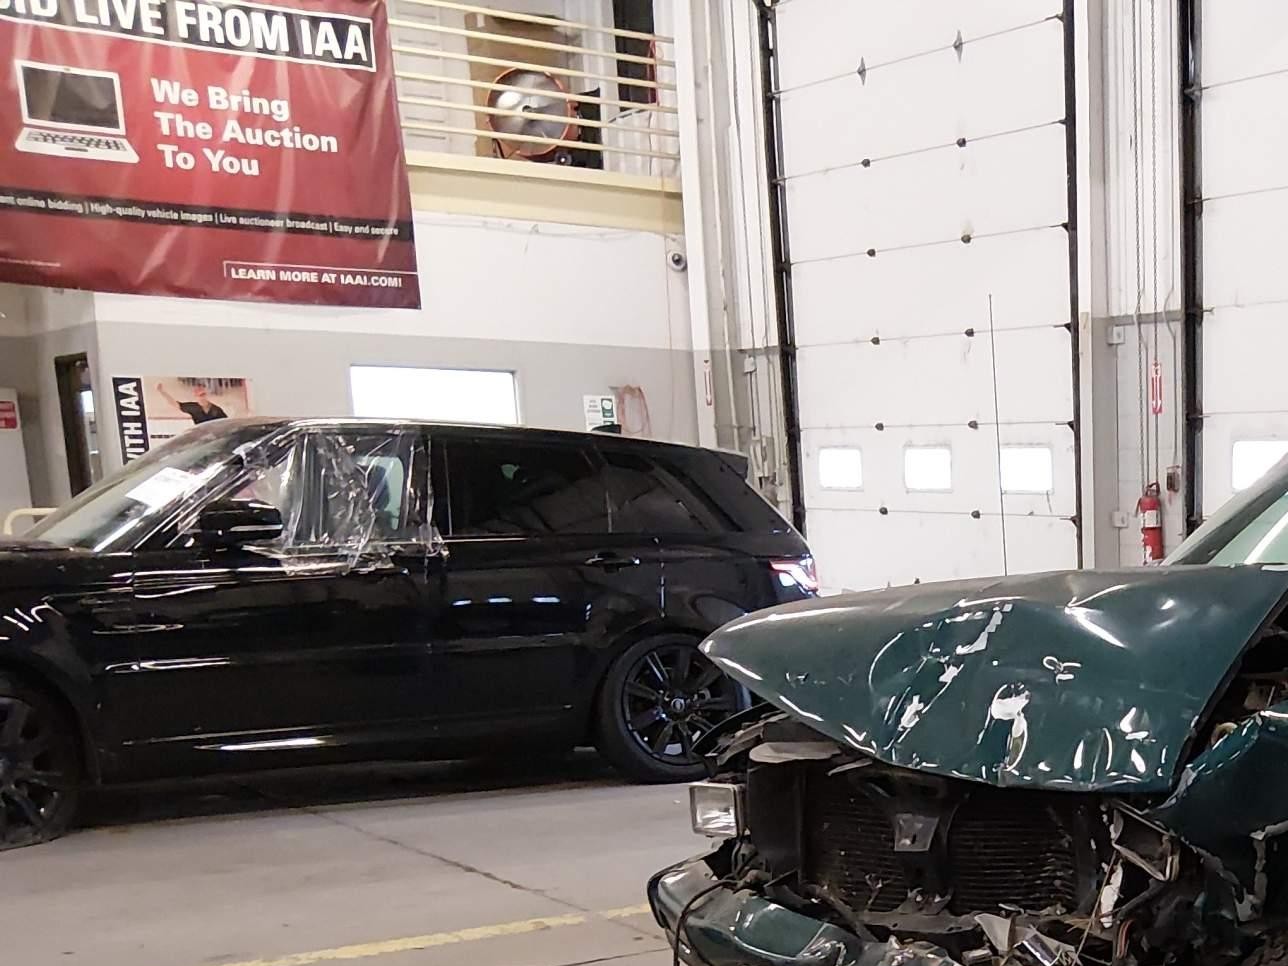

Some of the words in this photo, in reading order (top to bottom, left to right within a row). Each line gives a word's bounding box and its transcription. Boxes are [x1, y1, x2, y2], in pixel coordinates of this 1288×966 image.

[75, 0, 166, 35] LIVE
[175, 0, 290, 52] FROM
[300, 19, 368, 62] IAA
[150, 77, 199, 107] We
[207, 86, 290, 122] Bring
[153, 111, 213, 140] The
[222, 119, 338, 153] Auction
[156, 143, 196, 170] To
[202, 147, 260, 176] You
[220, 213, 237, 224] Live
[286, 218, 328, 231] broadcast
[231, 267, 277, 281] LEARN
[279, 270, 319, 283] MORE
[321, 273, 337, 284] AT
[117, 381, 141, 416] IAA
